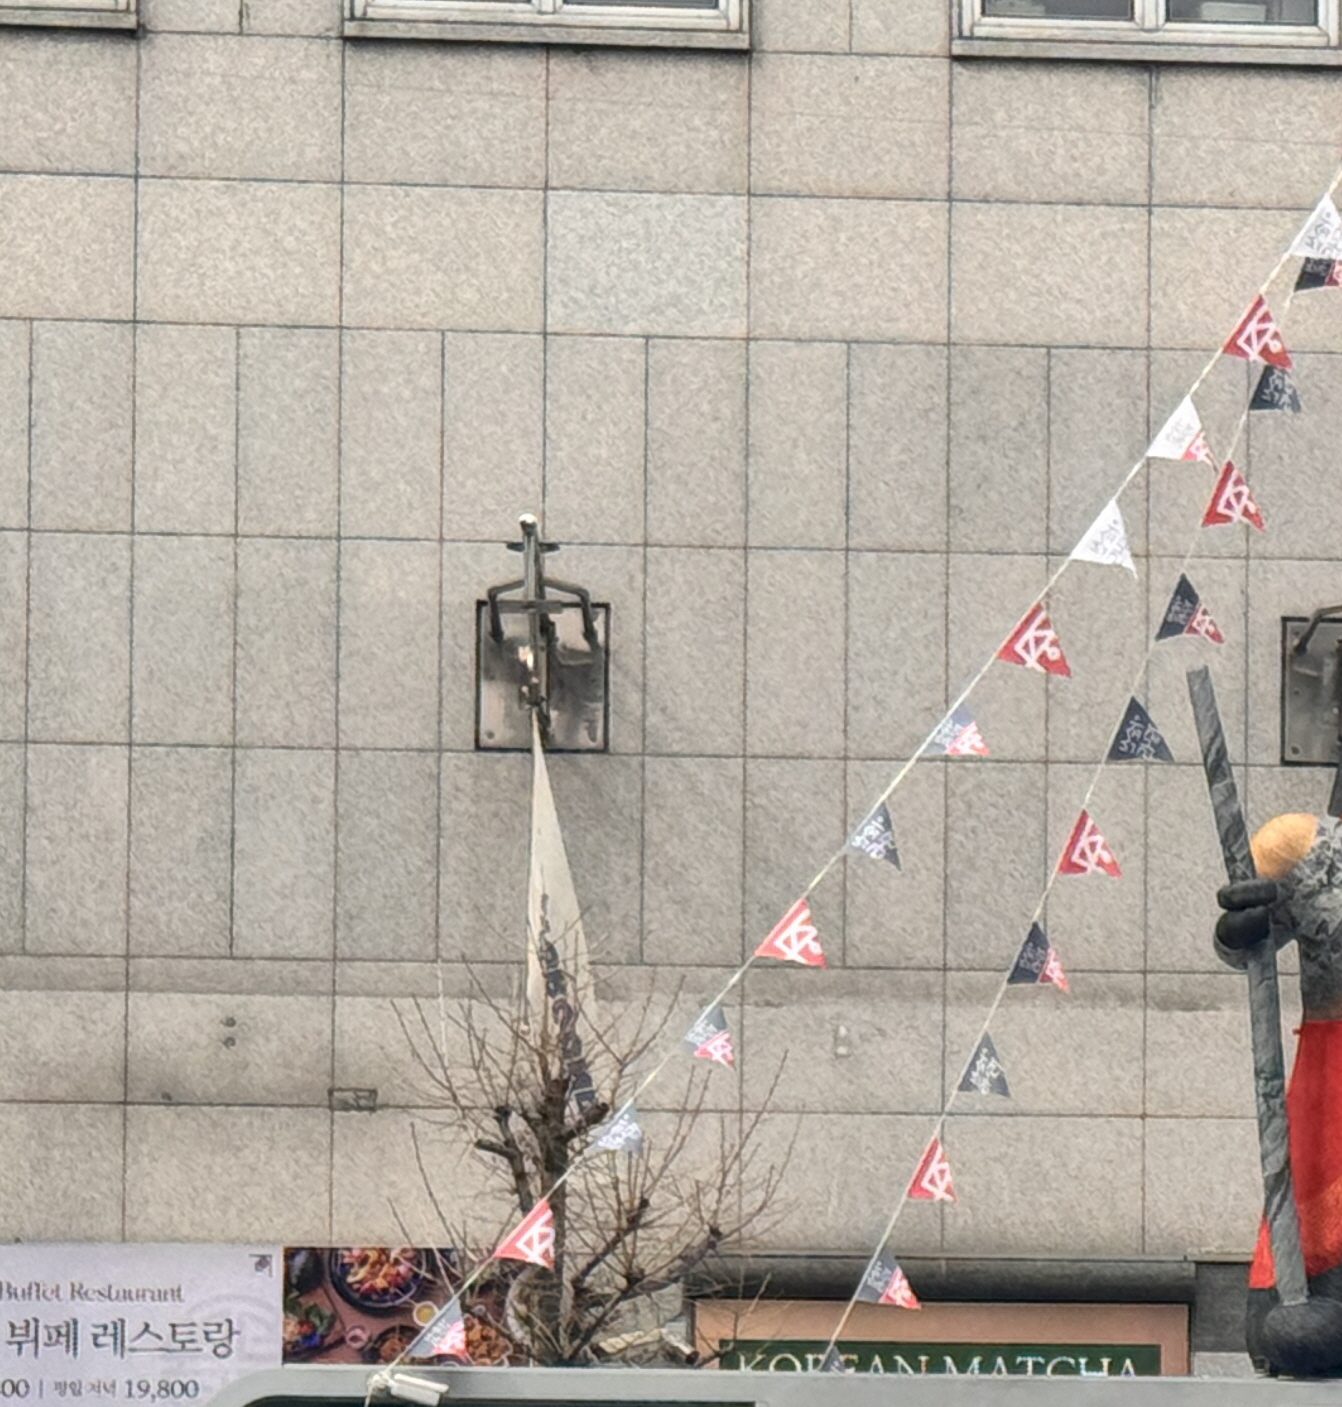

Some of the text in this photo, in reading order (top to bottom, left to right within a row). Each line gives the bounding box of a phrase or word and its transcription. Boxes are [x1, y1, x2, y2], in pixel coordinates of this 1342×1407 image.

[70, 1281, 185, 1301] Restaurant
[6, 1317, 242, 1359] 뷔페 레스토랑
[125, 1379, 200, 1403] 19,800
